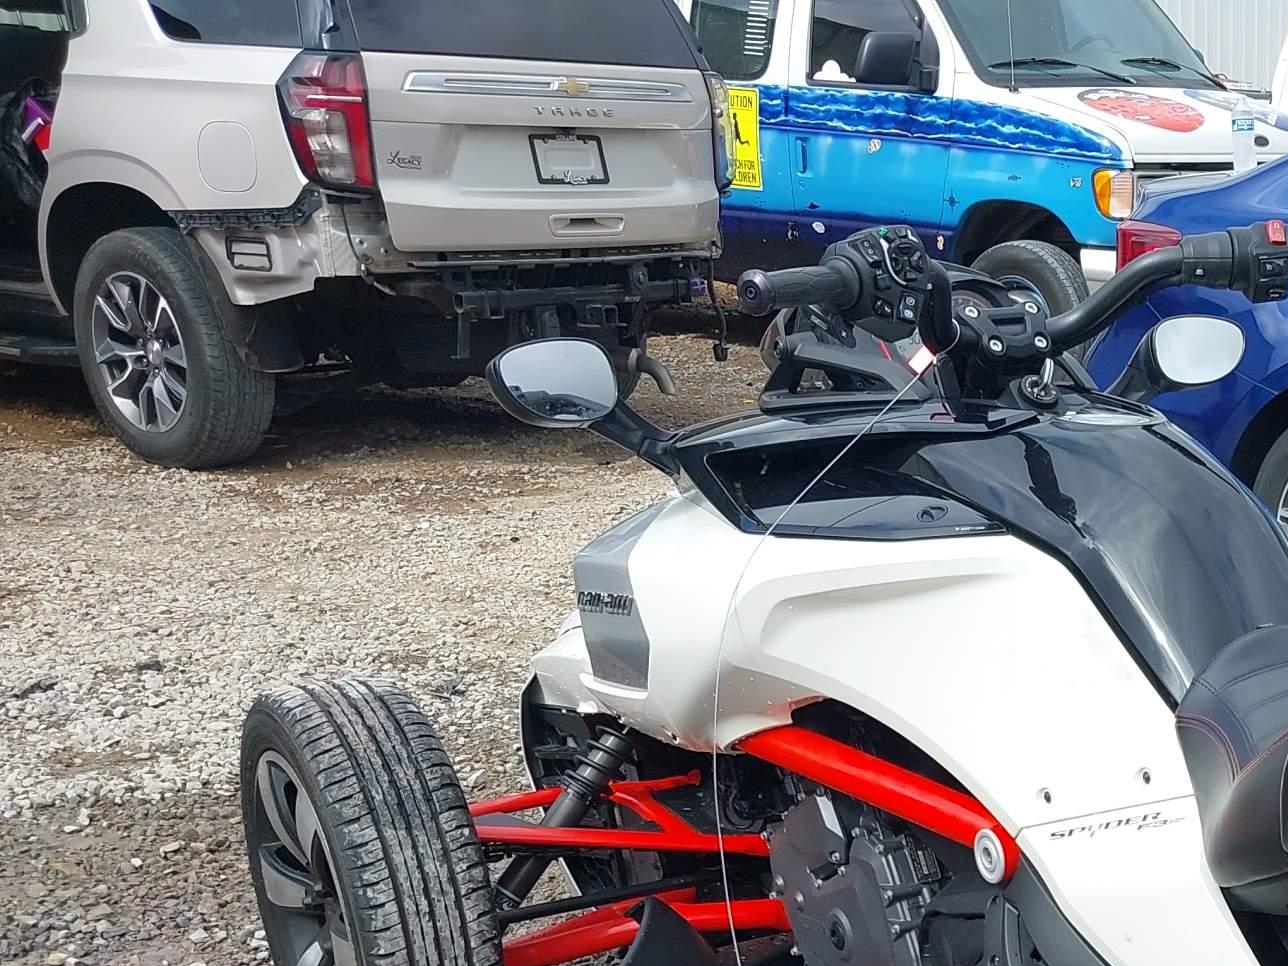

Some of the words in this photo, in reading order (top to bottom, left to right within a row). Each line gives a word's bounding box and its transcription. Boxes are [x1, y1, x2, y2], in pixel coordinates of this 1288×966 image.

[729, 95, 753, 109] UTION
[533, 106, 614, 118] TAHOE
[744, 159, 756, 171] FOR
[735, 171, 757, 184] LDREN
[1049, 811, 1162, 839] SPYDER
